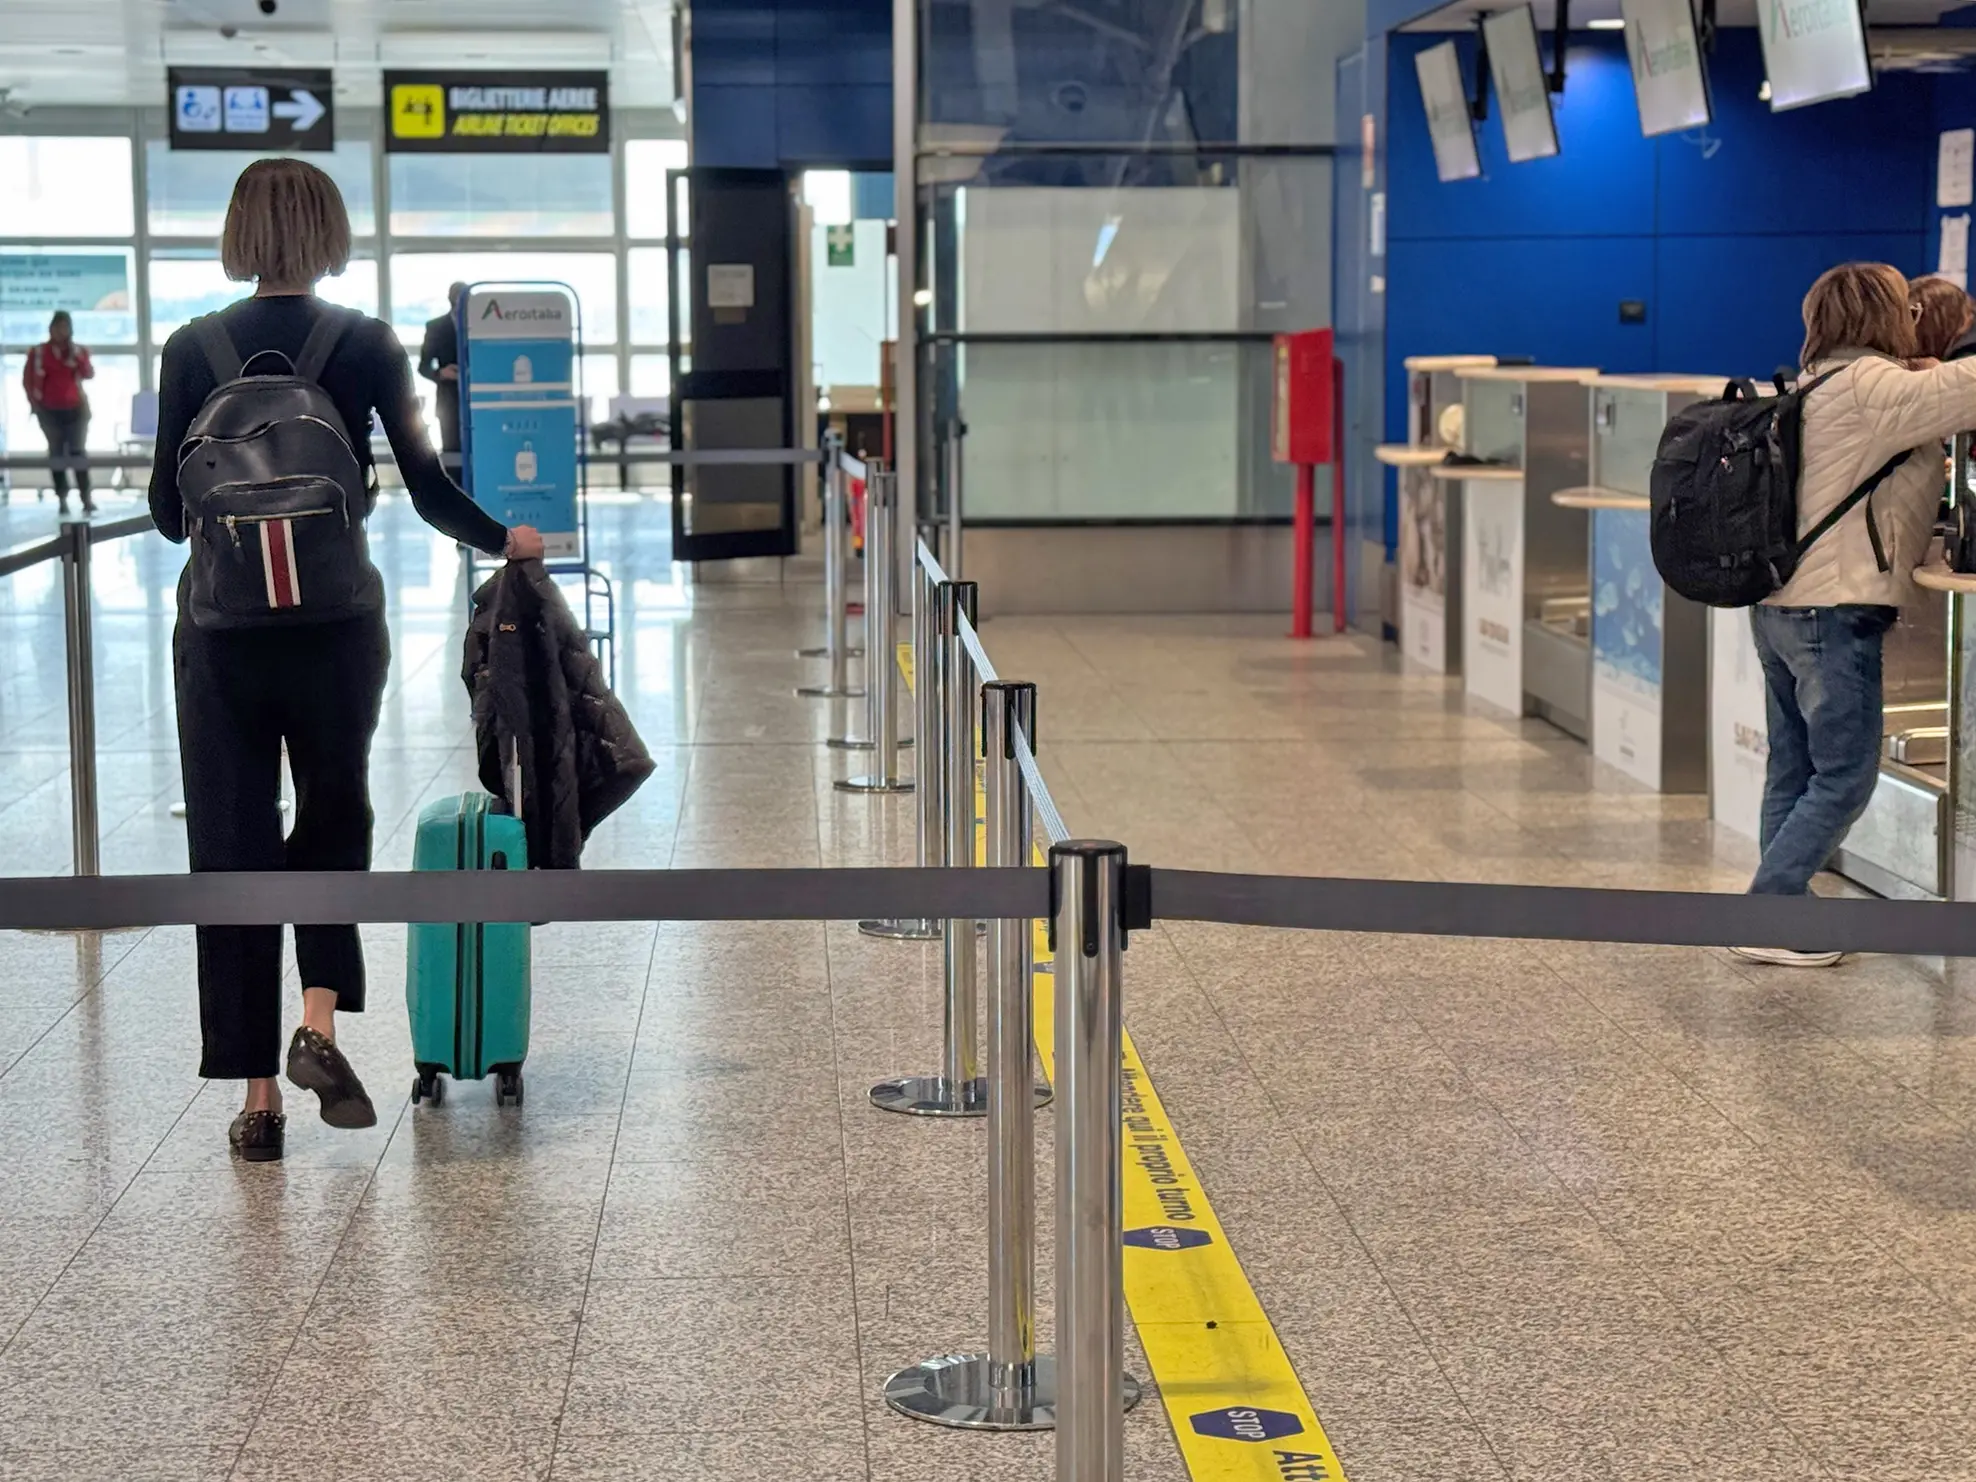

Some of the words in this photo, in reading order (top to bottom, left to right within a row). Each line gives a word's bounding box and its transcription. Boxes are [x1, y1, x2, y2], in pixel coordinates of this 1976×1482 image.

[481, 299, 562, 320] Aeroitalia
[1122, 1115, 1165, 1131] qui
[1132, 1132, 1169, 1142] il
[1128, 1143, 1187, 1185] proprio
[1155, 1187, 1196, 1221] turno
[1150, 1227, 1181, 1250] STOP
[1227, 1409, 1267, 1440] STOP
